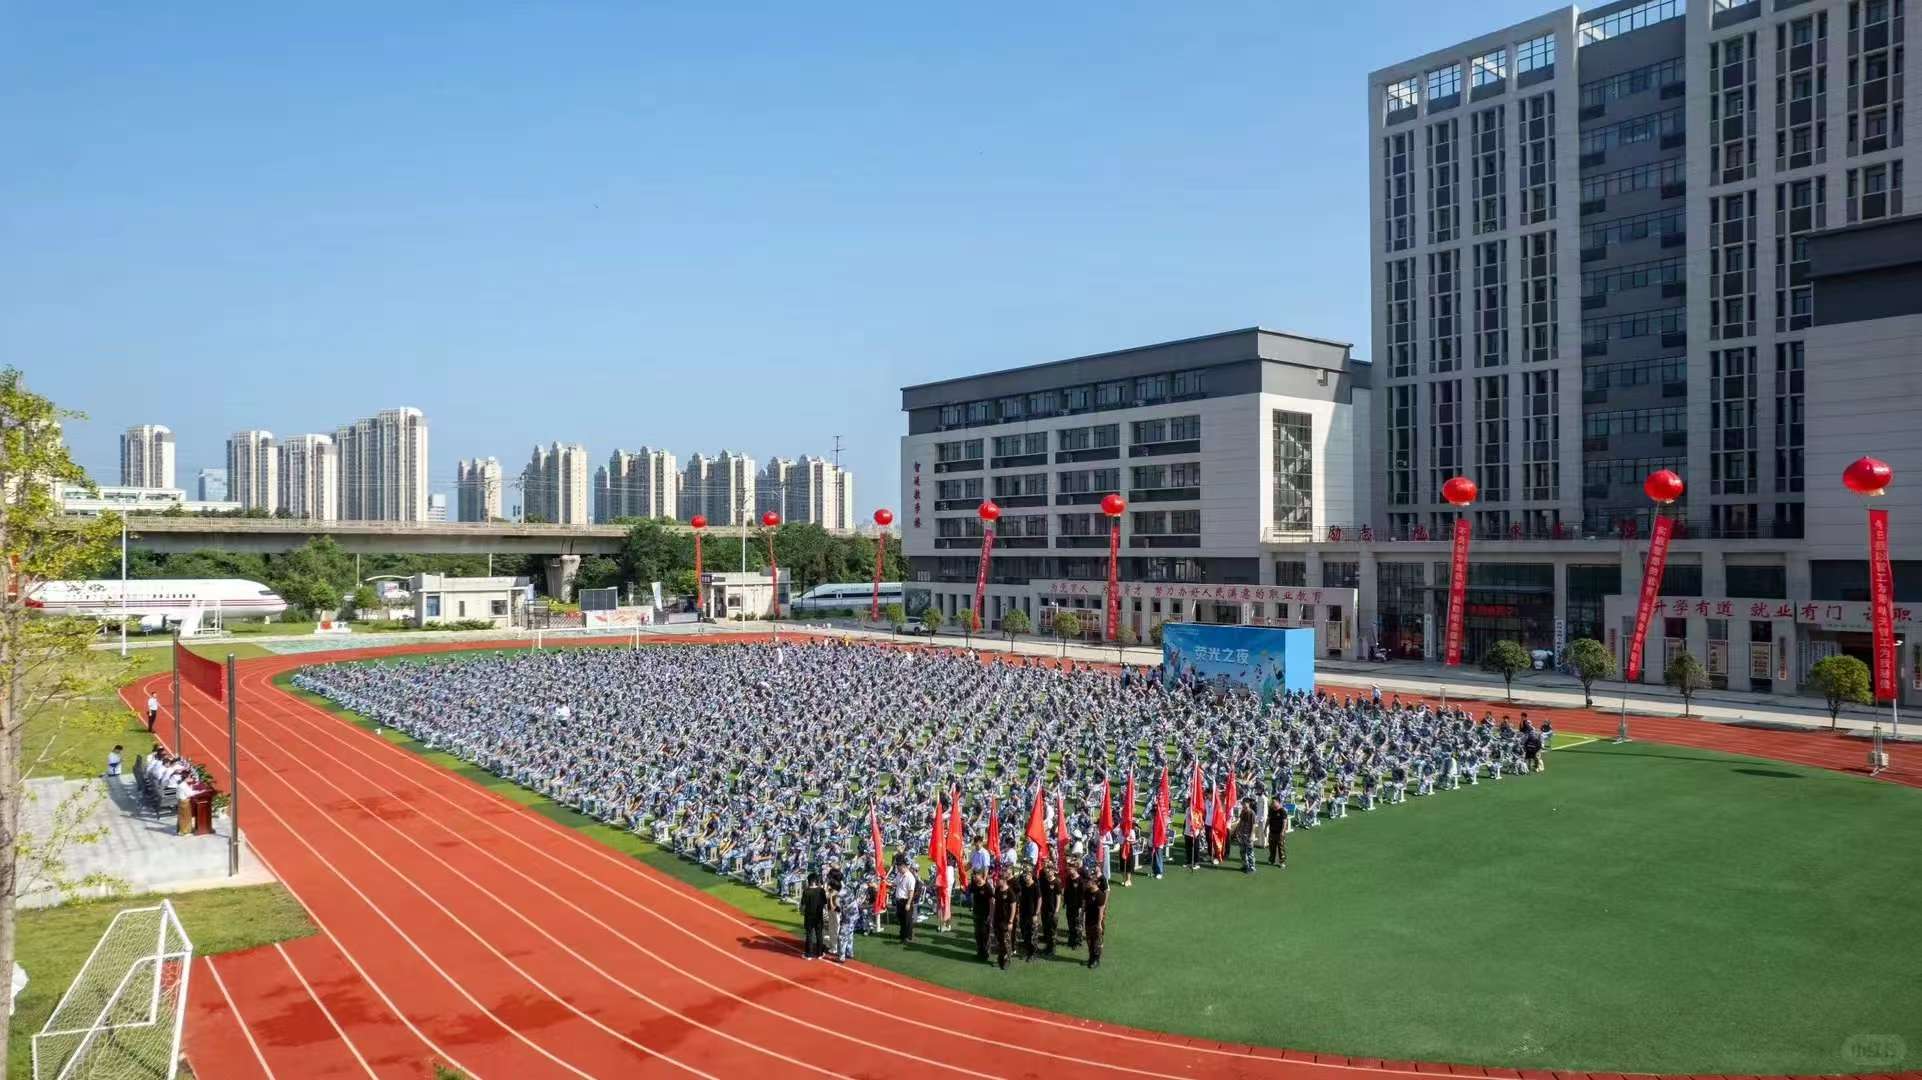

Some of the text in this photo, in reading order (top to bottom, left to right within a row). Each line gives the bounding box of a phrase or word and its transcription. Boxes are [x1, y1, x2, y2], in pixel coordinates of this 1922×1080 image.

[1654, 600, 1735, 617] 升学有道
[1750, 602, 1842, 620] 就业有门
[1193, 646, 1249, 665] 荧光之夜
